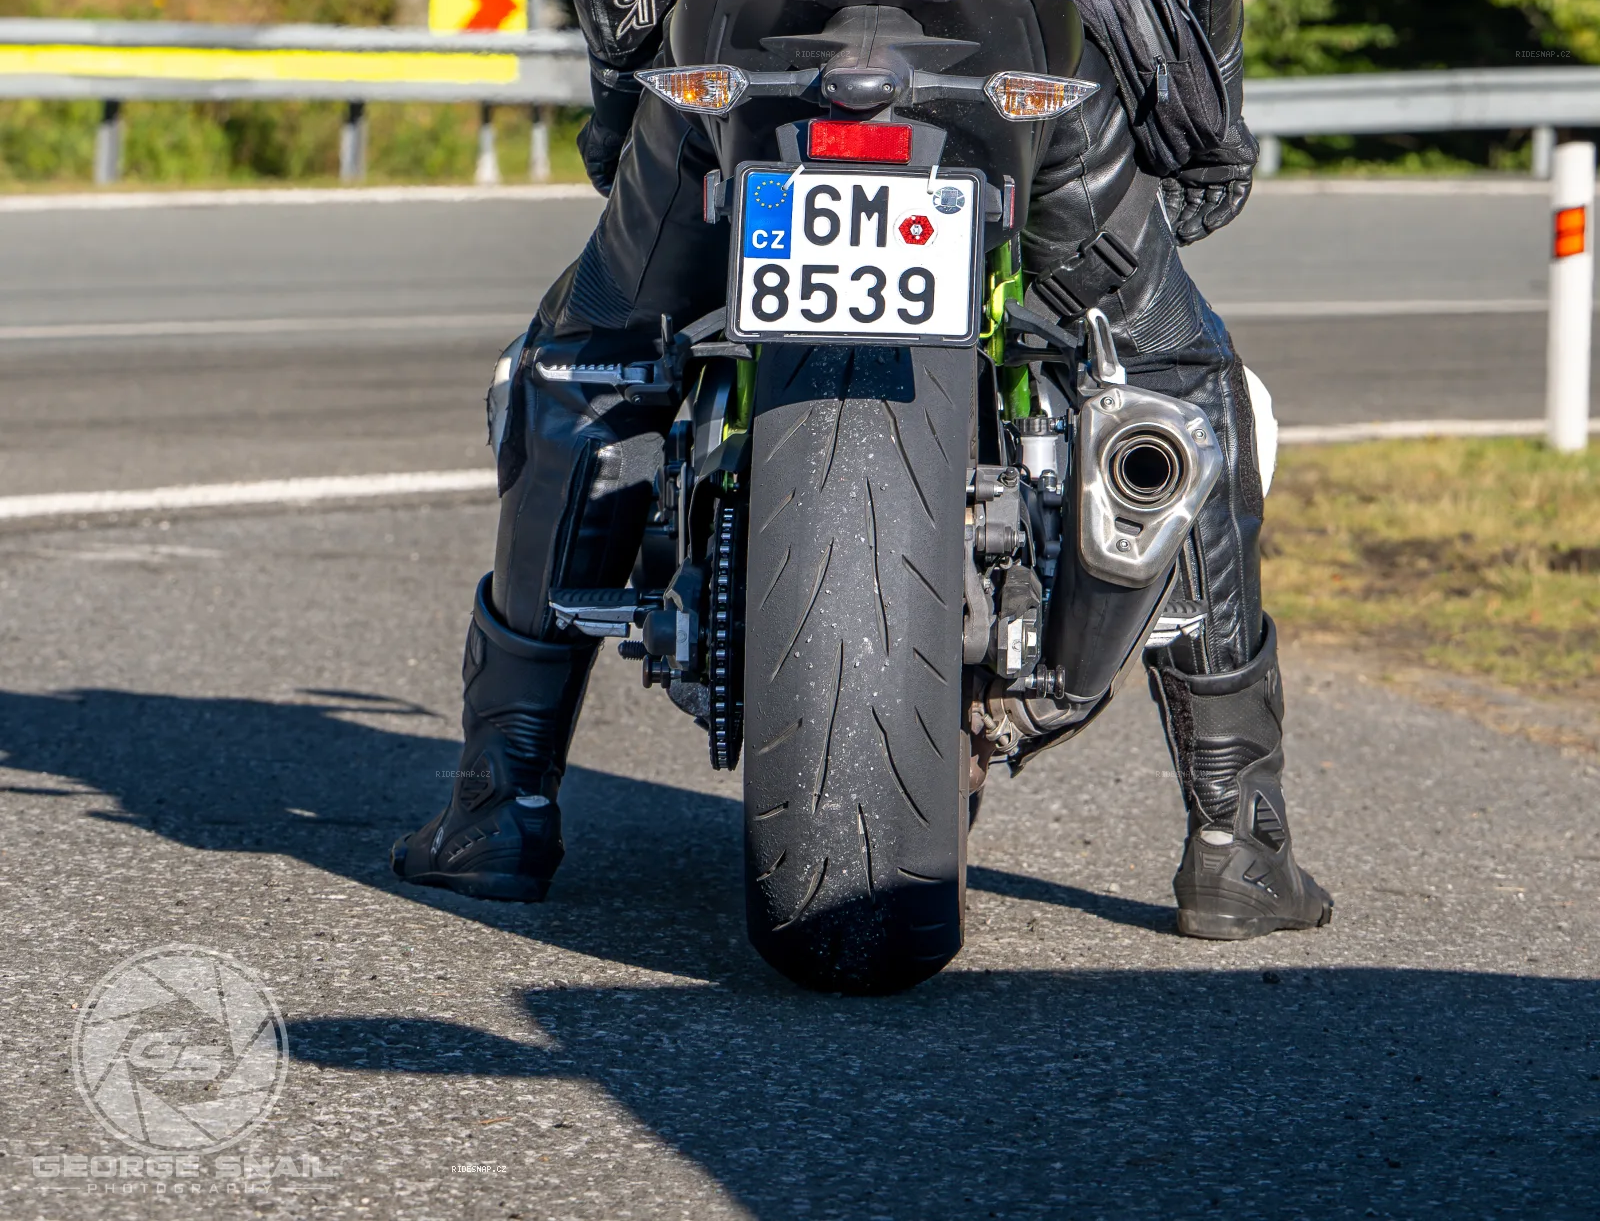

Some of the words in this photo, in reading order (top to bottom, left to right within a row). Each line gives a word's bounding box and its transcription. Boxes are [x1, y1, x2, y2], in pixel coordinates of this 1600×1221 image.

[752, 229, 785, 249] CZ
[803, 184, 889, 247] 6M
[752, 263, 935, 325] 8539
